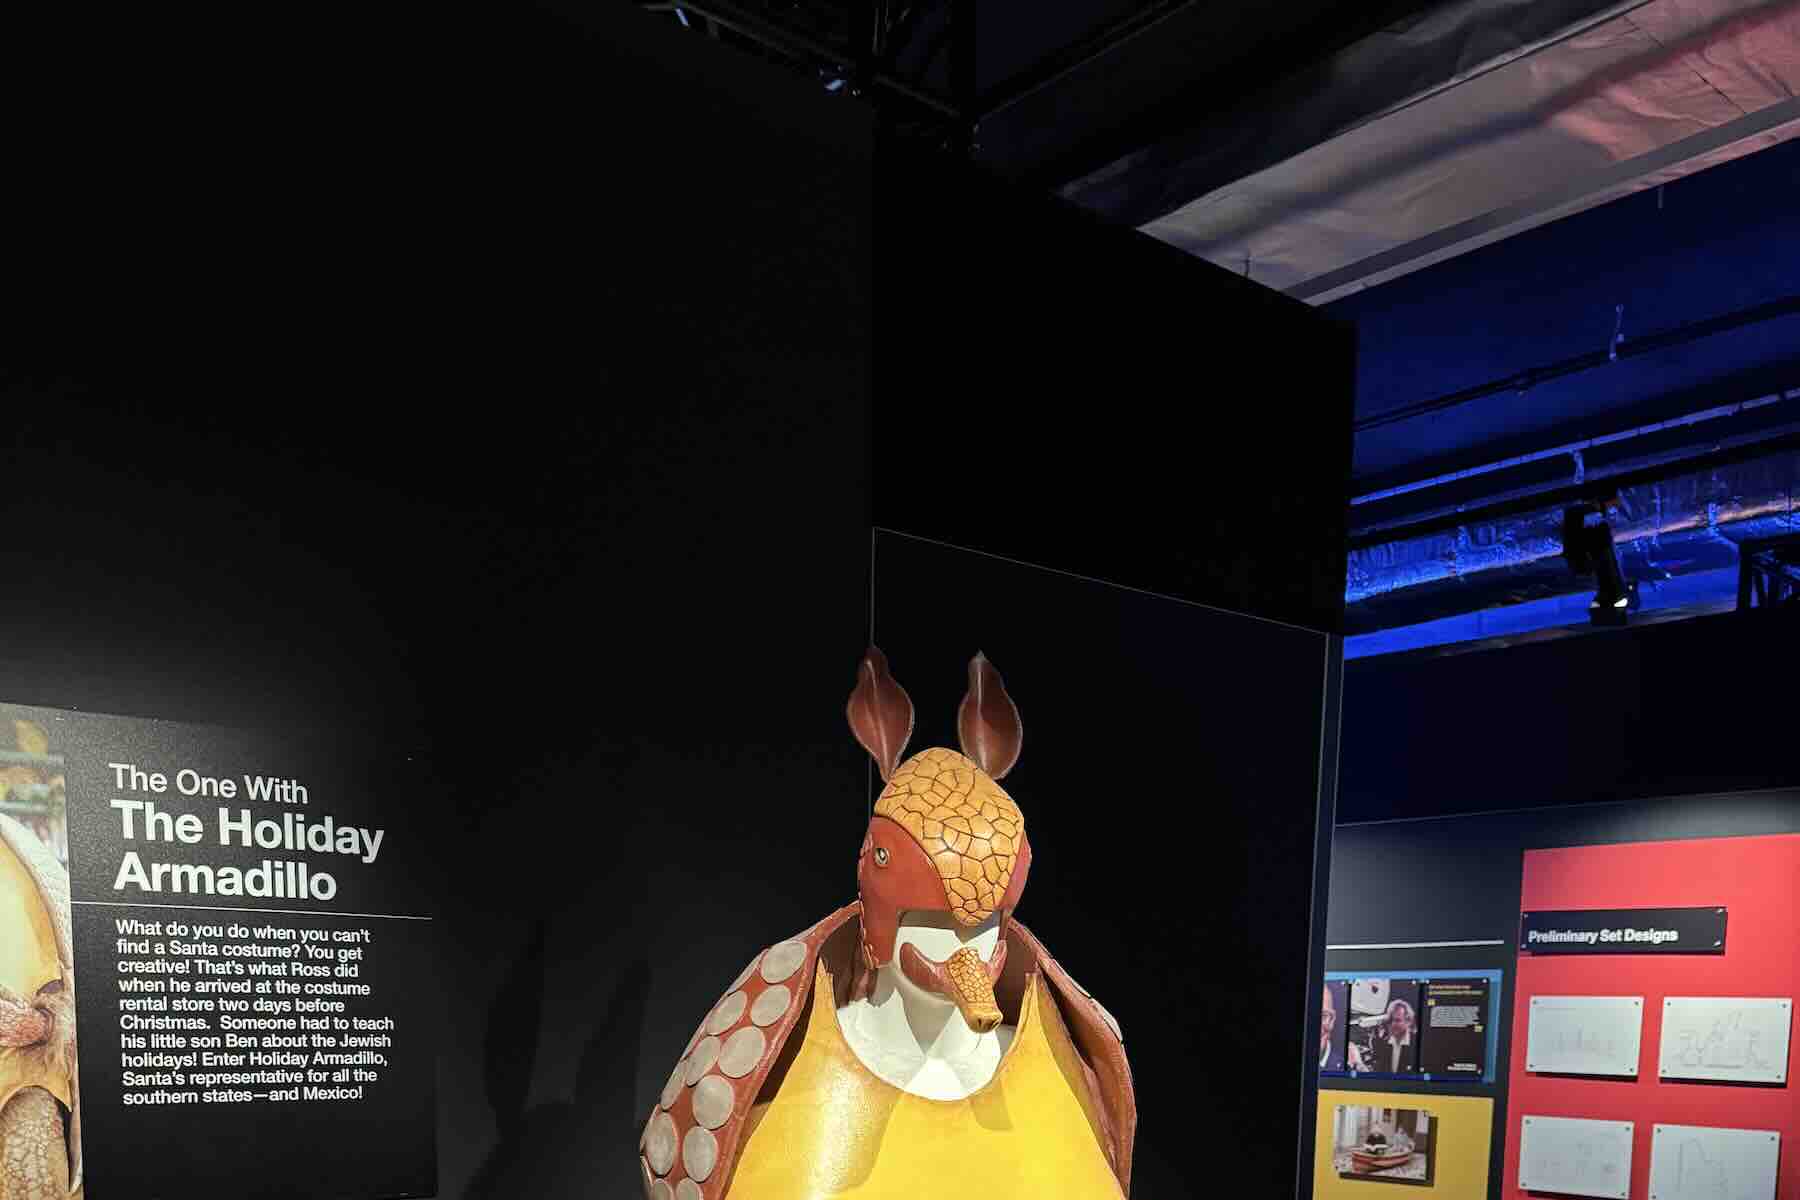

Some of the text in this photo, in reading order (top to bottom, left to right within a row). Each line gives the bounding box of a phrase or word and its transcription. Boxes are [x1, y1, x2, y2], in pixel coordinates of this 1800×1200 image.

[108, 763, 309, 805] The One With
[110, 799, 385, 863] The Holiday
[113, 852, 337, 901] Armadillo
[116, 920, 371, 943] What do you do when you can’t
[1528, 928, 1679, 945] Preliminary Set Designs
[116, 939, 363, 962] find a Santa costume? You get
[118, 959, 359, 977] creative! That’s what Ross did
[119, 978, 371, 995] when he arrived at the costume
[119, 997, 345, 1014] rental store two days before
[120, 1015, 395, 1030] Christmas. Someone had to teach
[120, 1034, 391, 1048] his little son Ben about the Jewish
[121, 1051, 388, 1070] holidays! Enter Holiday Armadillo,
[122, 1069, 377, 1088] Santa’s representative for all the
[122, 1090, 198, 1104] southern
[302, 1086, 363, 1099] Mexico!
